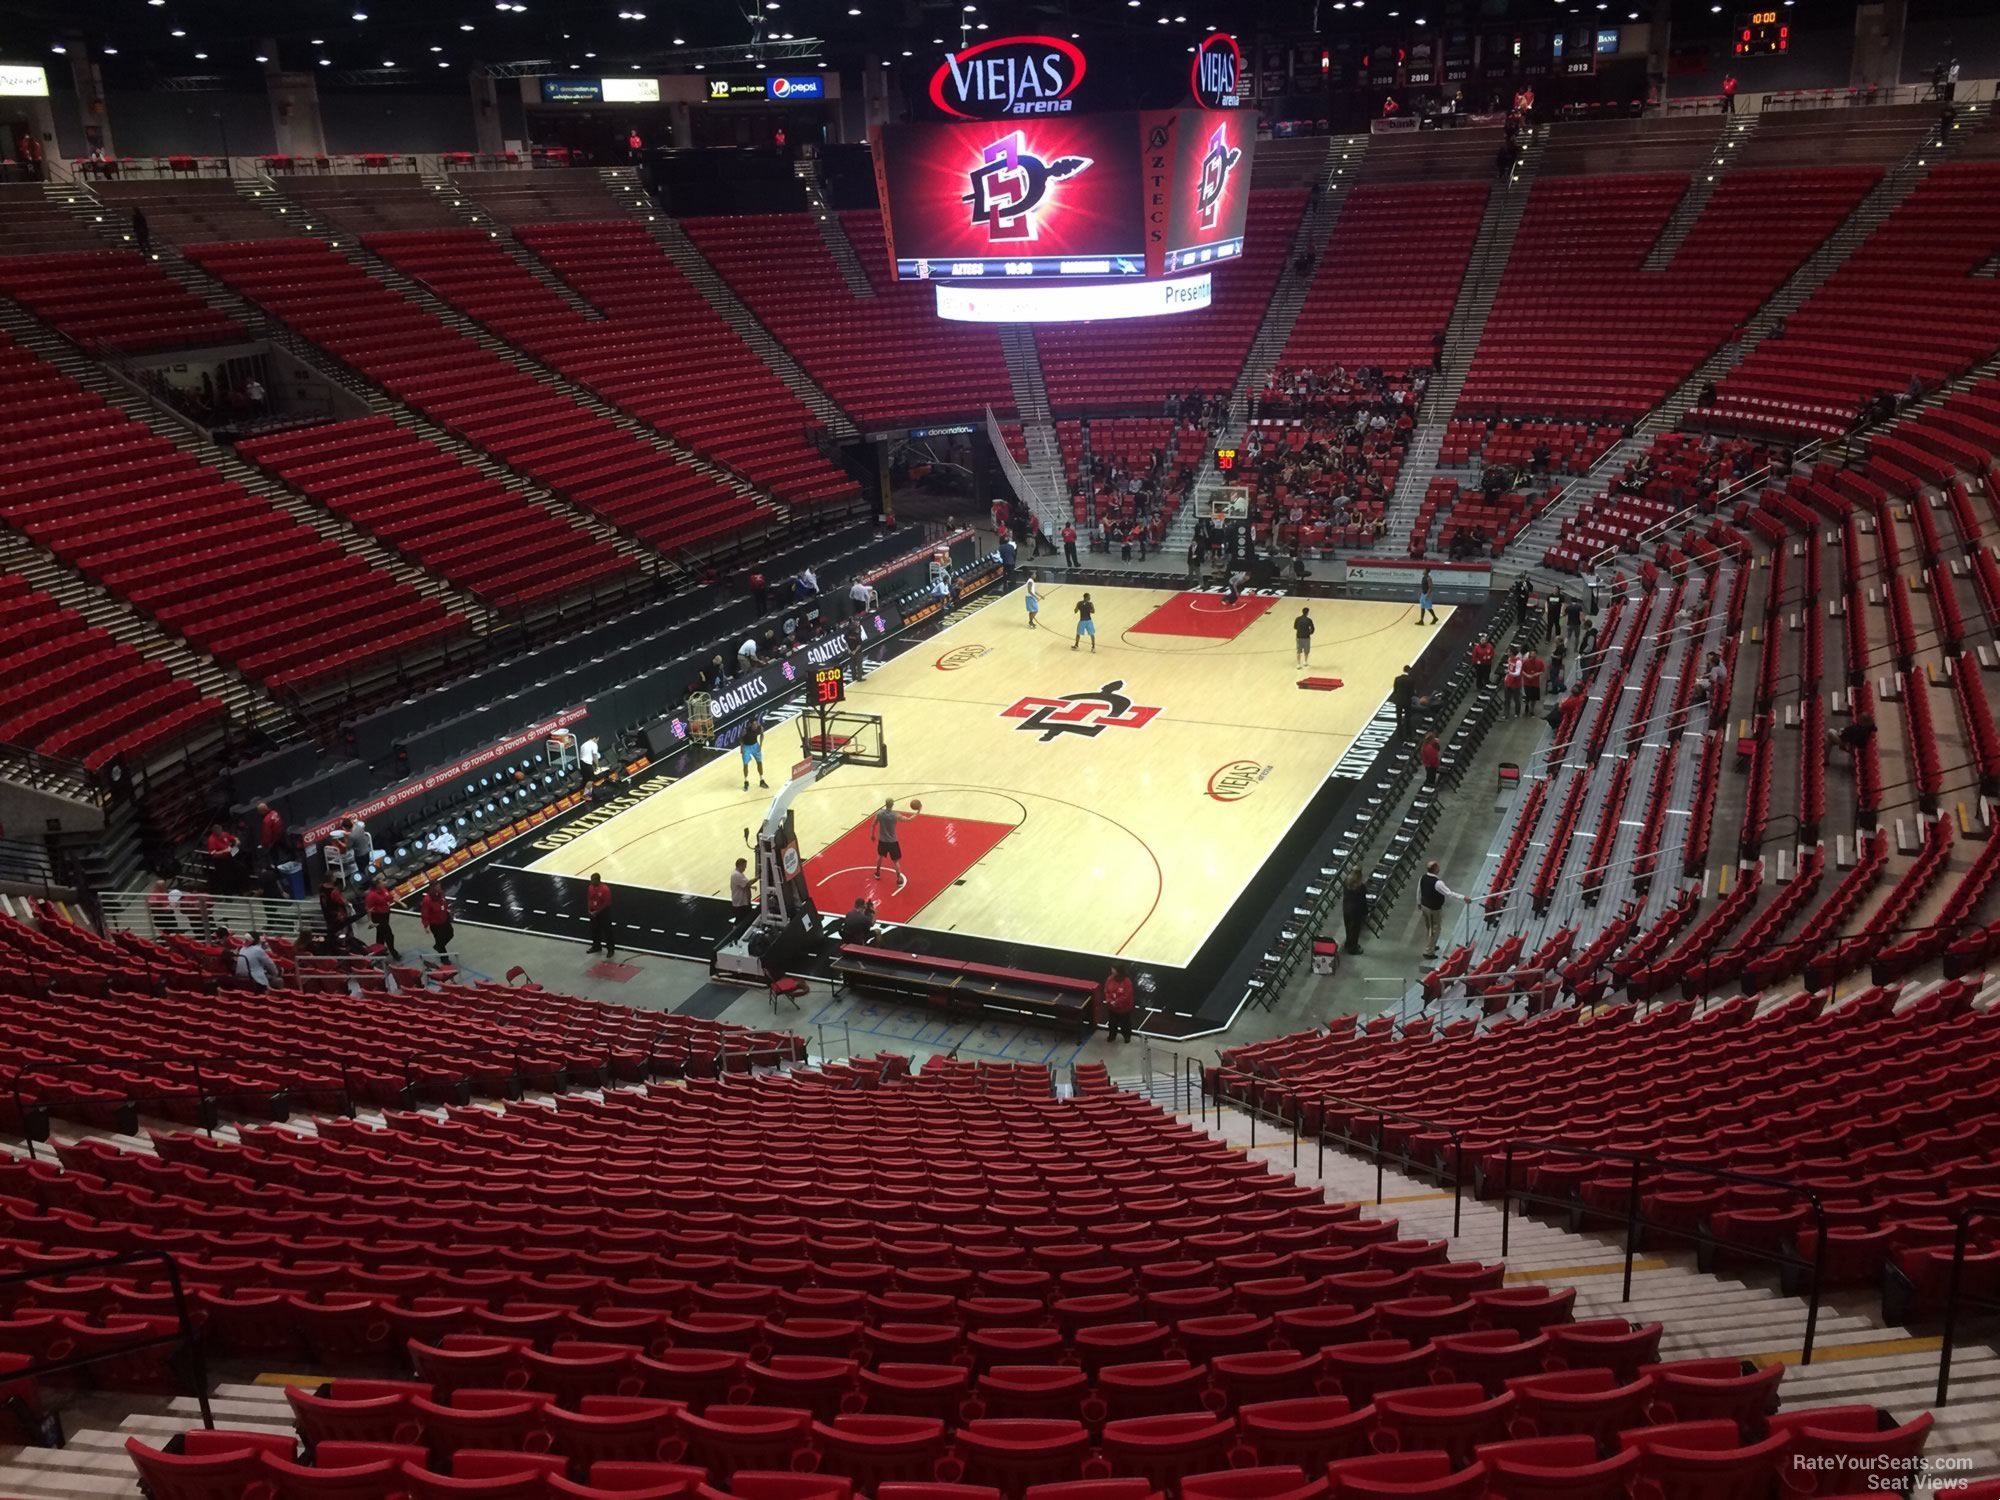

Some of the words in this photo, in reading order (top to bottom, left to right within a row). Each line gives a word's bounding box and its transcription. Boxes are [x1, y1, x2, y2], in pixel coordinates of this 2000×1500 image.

[1752, 12, 1776, 24] 10:00
[1743, 30, 1751, 41] 0
[1780, 27, 1788, 38] 0
[1199, 43, 1234, 104] VIEJAS
[1568, 63, 1588, 73] 2013
[790, 82, 817, 93] pepsi
[945, 53, 1063, 113] VIEJAS
[1013, 99, 1073, 114] arena
[1219, 458, 1233, 469] 30
[816, 668, 841, 683] 10:00
[710, 676, 768, 719] @GOAZTECS
[818, 681, 838, 702] 30
[1355, 719, 1398, 749] DIEGO
[358, 801, 385, 819] TOYOTA
[397, 783, 424, 801] TOYOTA
[435, 766, 461, 783] TOYOTA
[470, 751, 495, 767] TOYOTA
[503, 736, 527, 751] TOYOTA
[535, 722, 558, 736] TOYOTA
[566, 708, 588, 722] TOYOTA
[1331, 747, 1380, 780] STATE
[532, 774, 679, 851] GOAZTECS.COM
